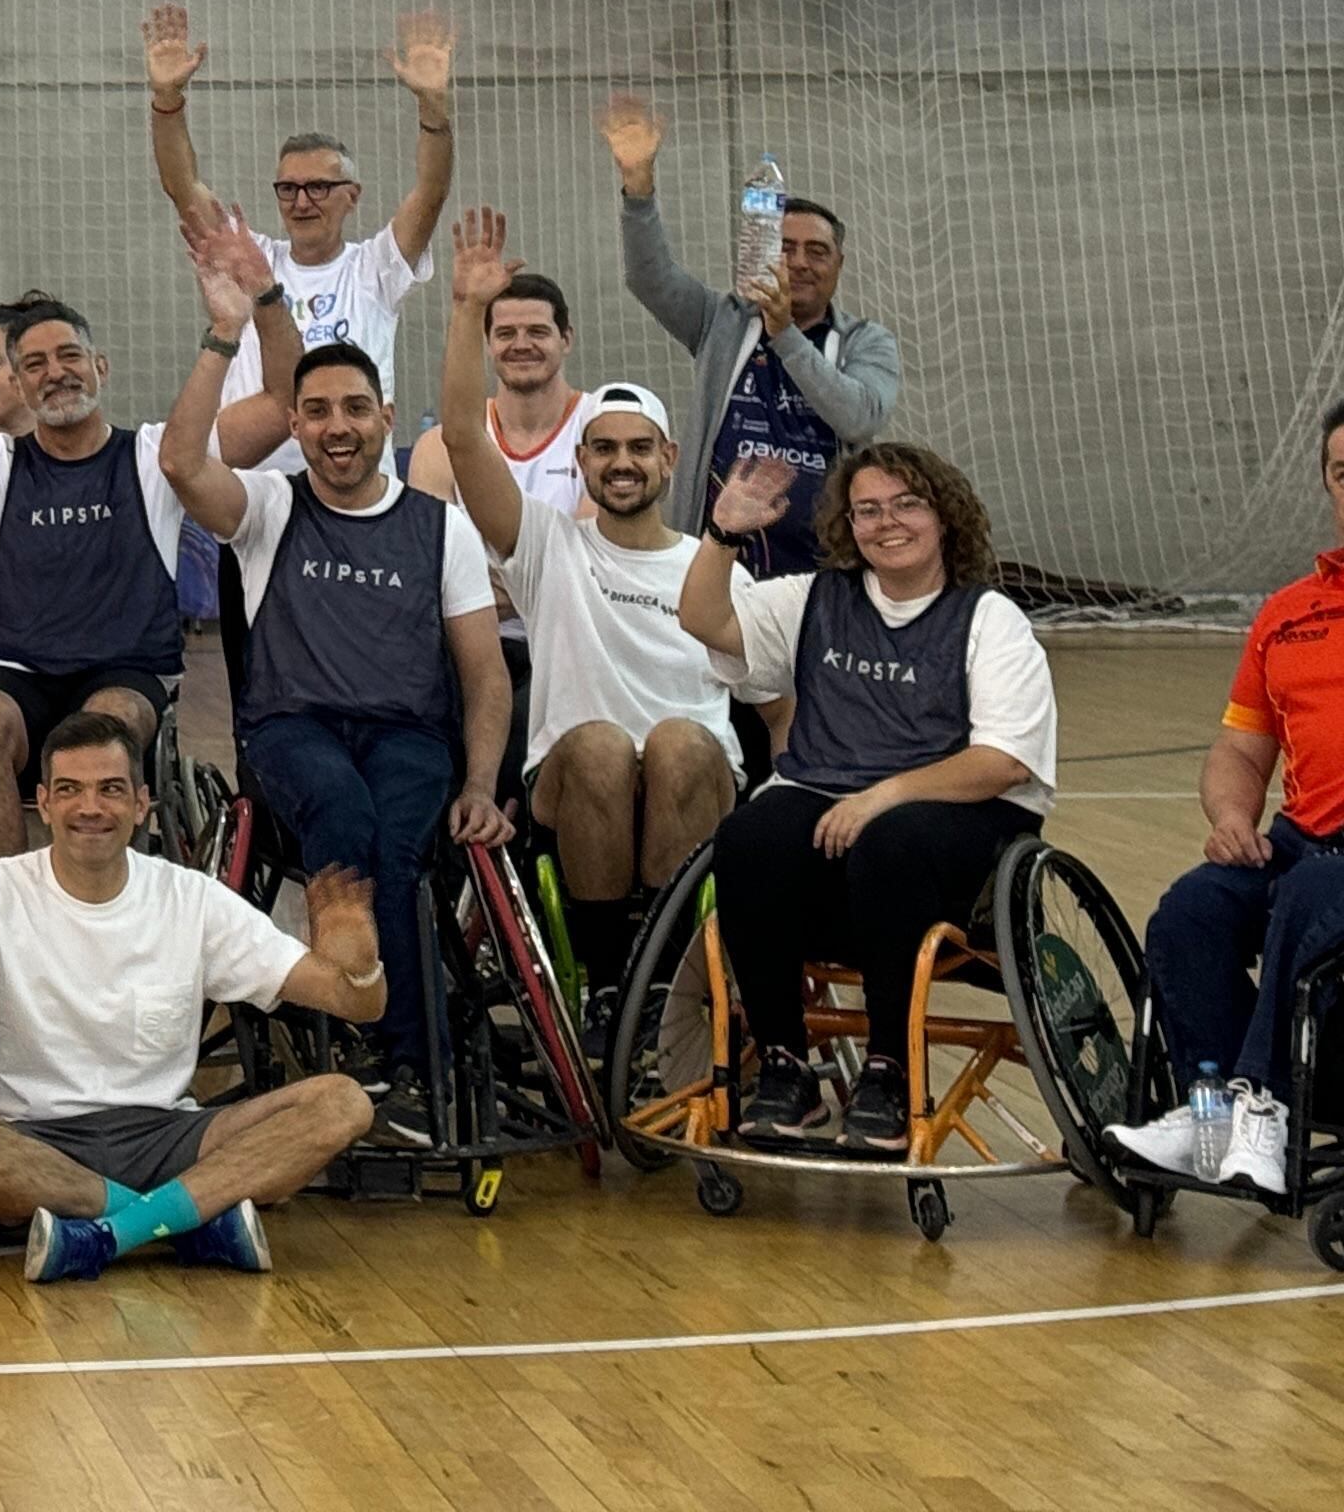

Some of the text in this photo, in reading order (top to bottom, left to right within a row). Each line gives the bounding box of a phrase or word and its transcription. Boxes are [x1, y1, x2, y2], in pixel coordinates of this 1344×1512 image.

[737, 439, 827, 470] gaviota
[31, 503, 112, 526] KIPSTA
[302, 559, 403, 588] KIPSTA
[822, 647, 917, 685] KIPSTA
